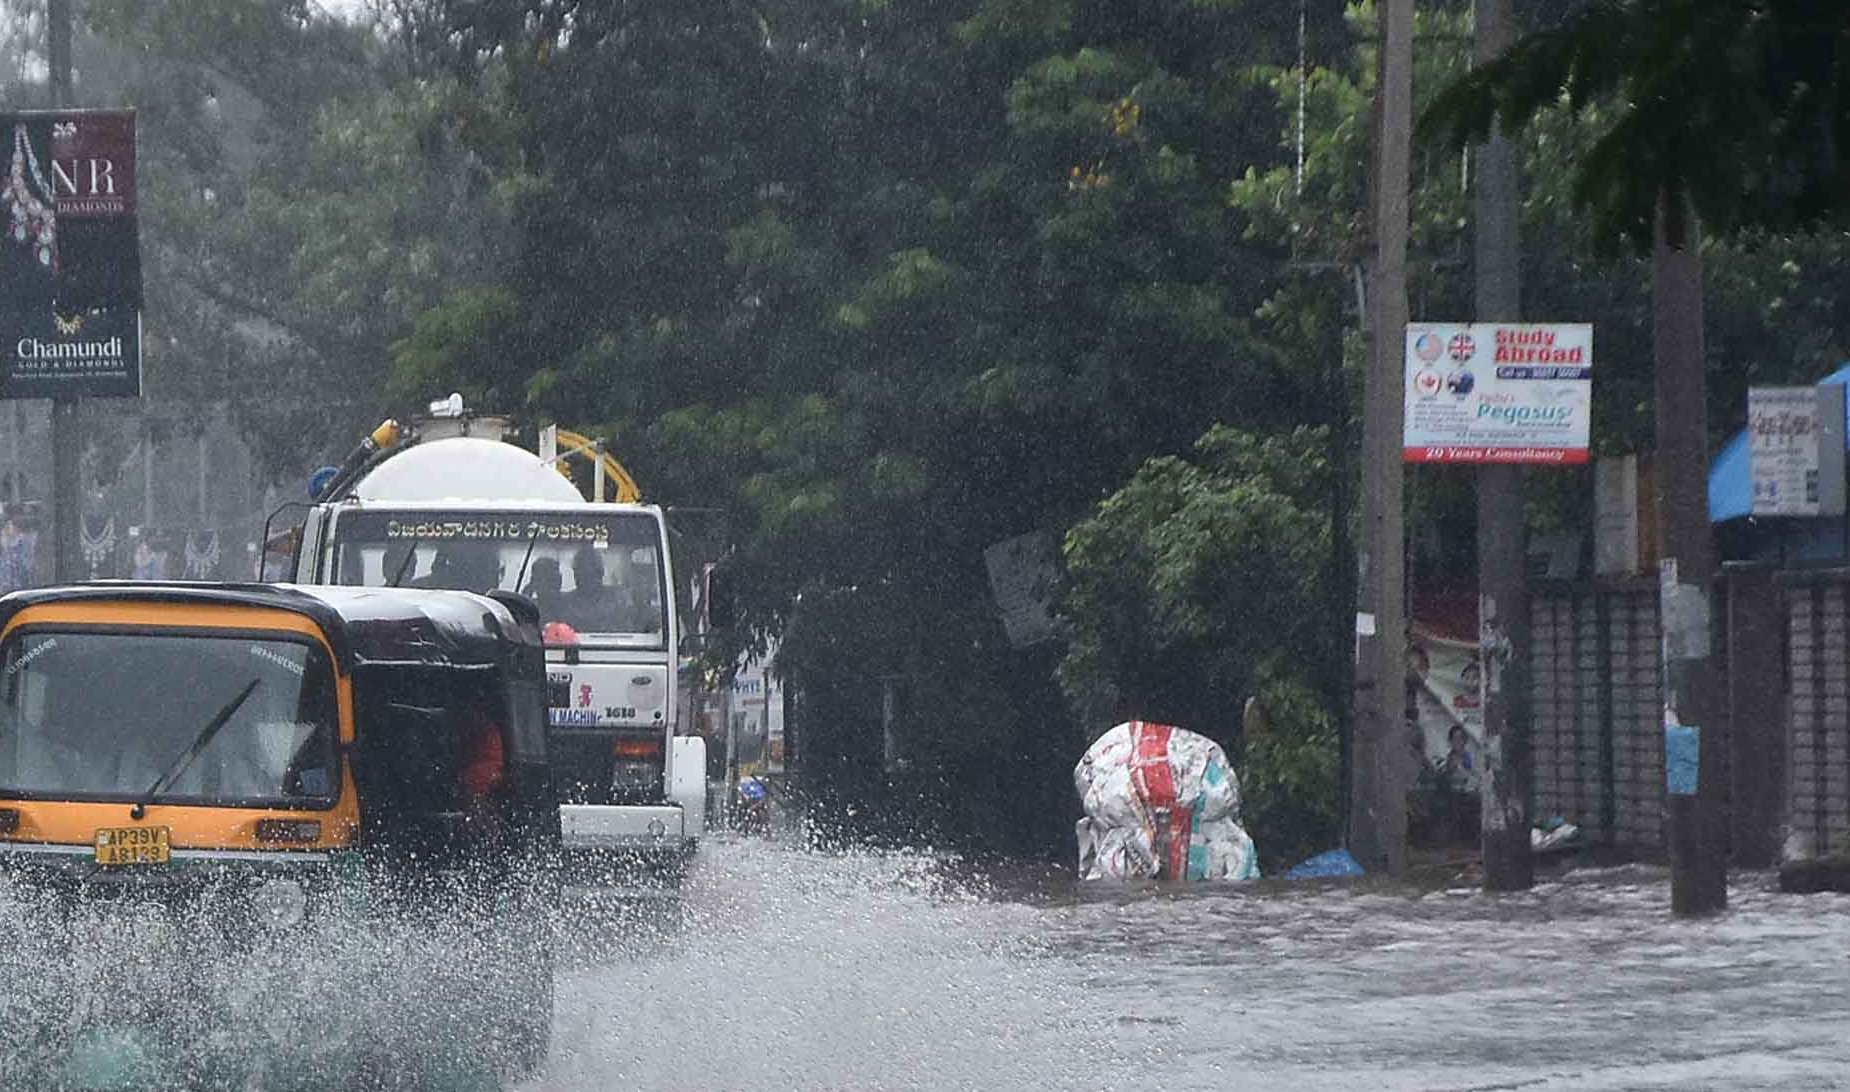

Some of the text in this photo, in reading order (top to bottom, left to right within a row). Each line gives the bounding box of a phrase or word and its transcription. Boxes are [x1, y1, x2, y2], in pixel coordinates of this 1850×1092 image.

[51, 159, 117, 195] NR
[57, 203, 124, 213] DIAMONDS
[1495, 329, 1556, 346] Study
[17, 337, 122, 359] Chamundi
[1494, 346, 1583, 364] Abroad
[65, 360, 125, 368] DIAMONDS
[1477, 404, 1568, 426] Pegasus
[1425, 448, 1566, 461] 20 Years Consultancy
[559, 709, 602, 724] MACHIN
[108, 827, 159, 845] AP39V
